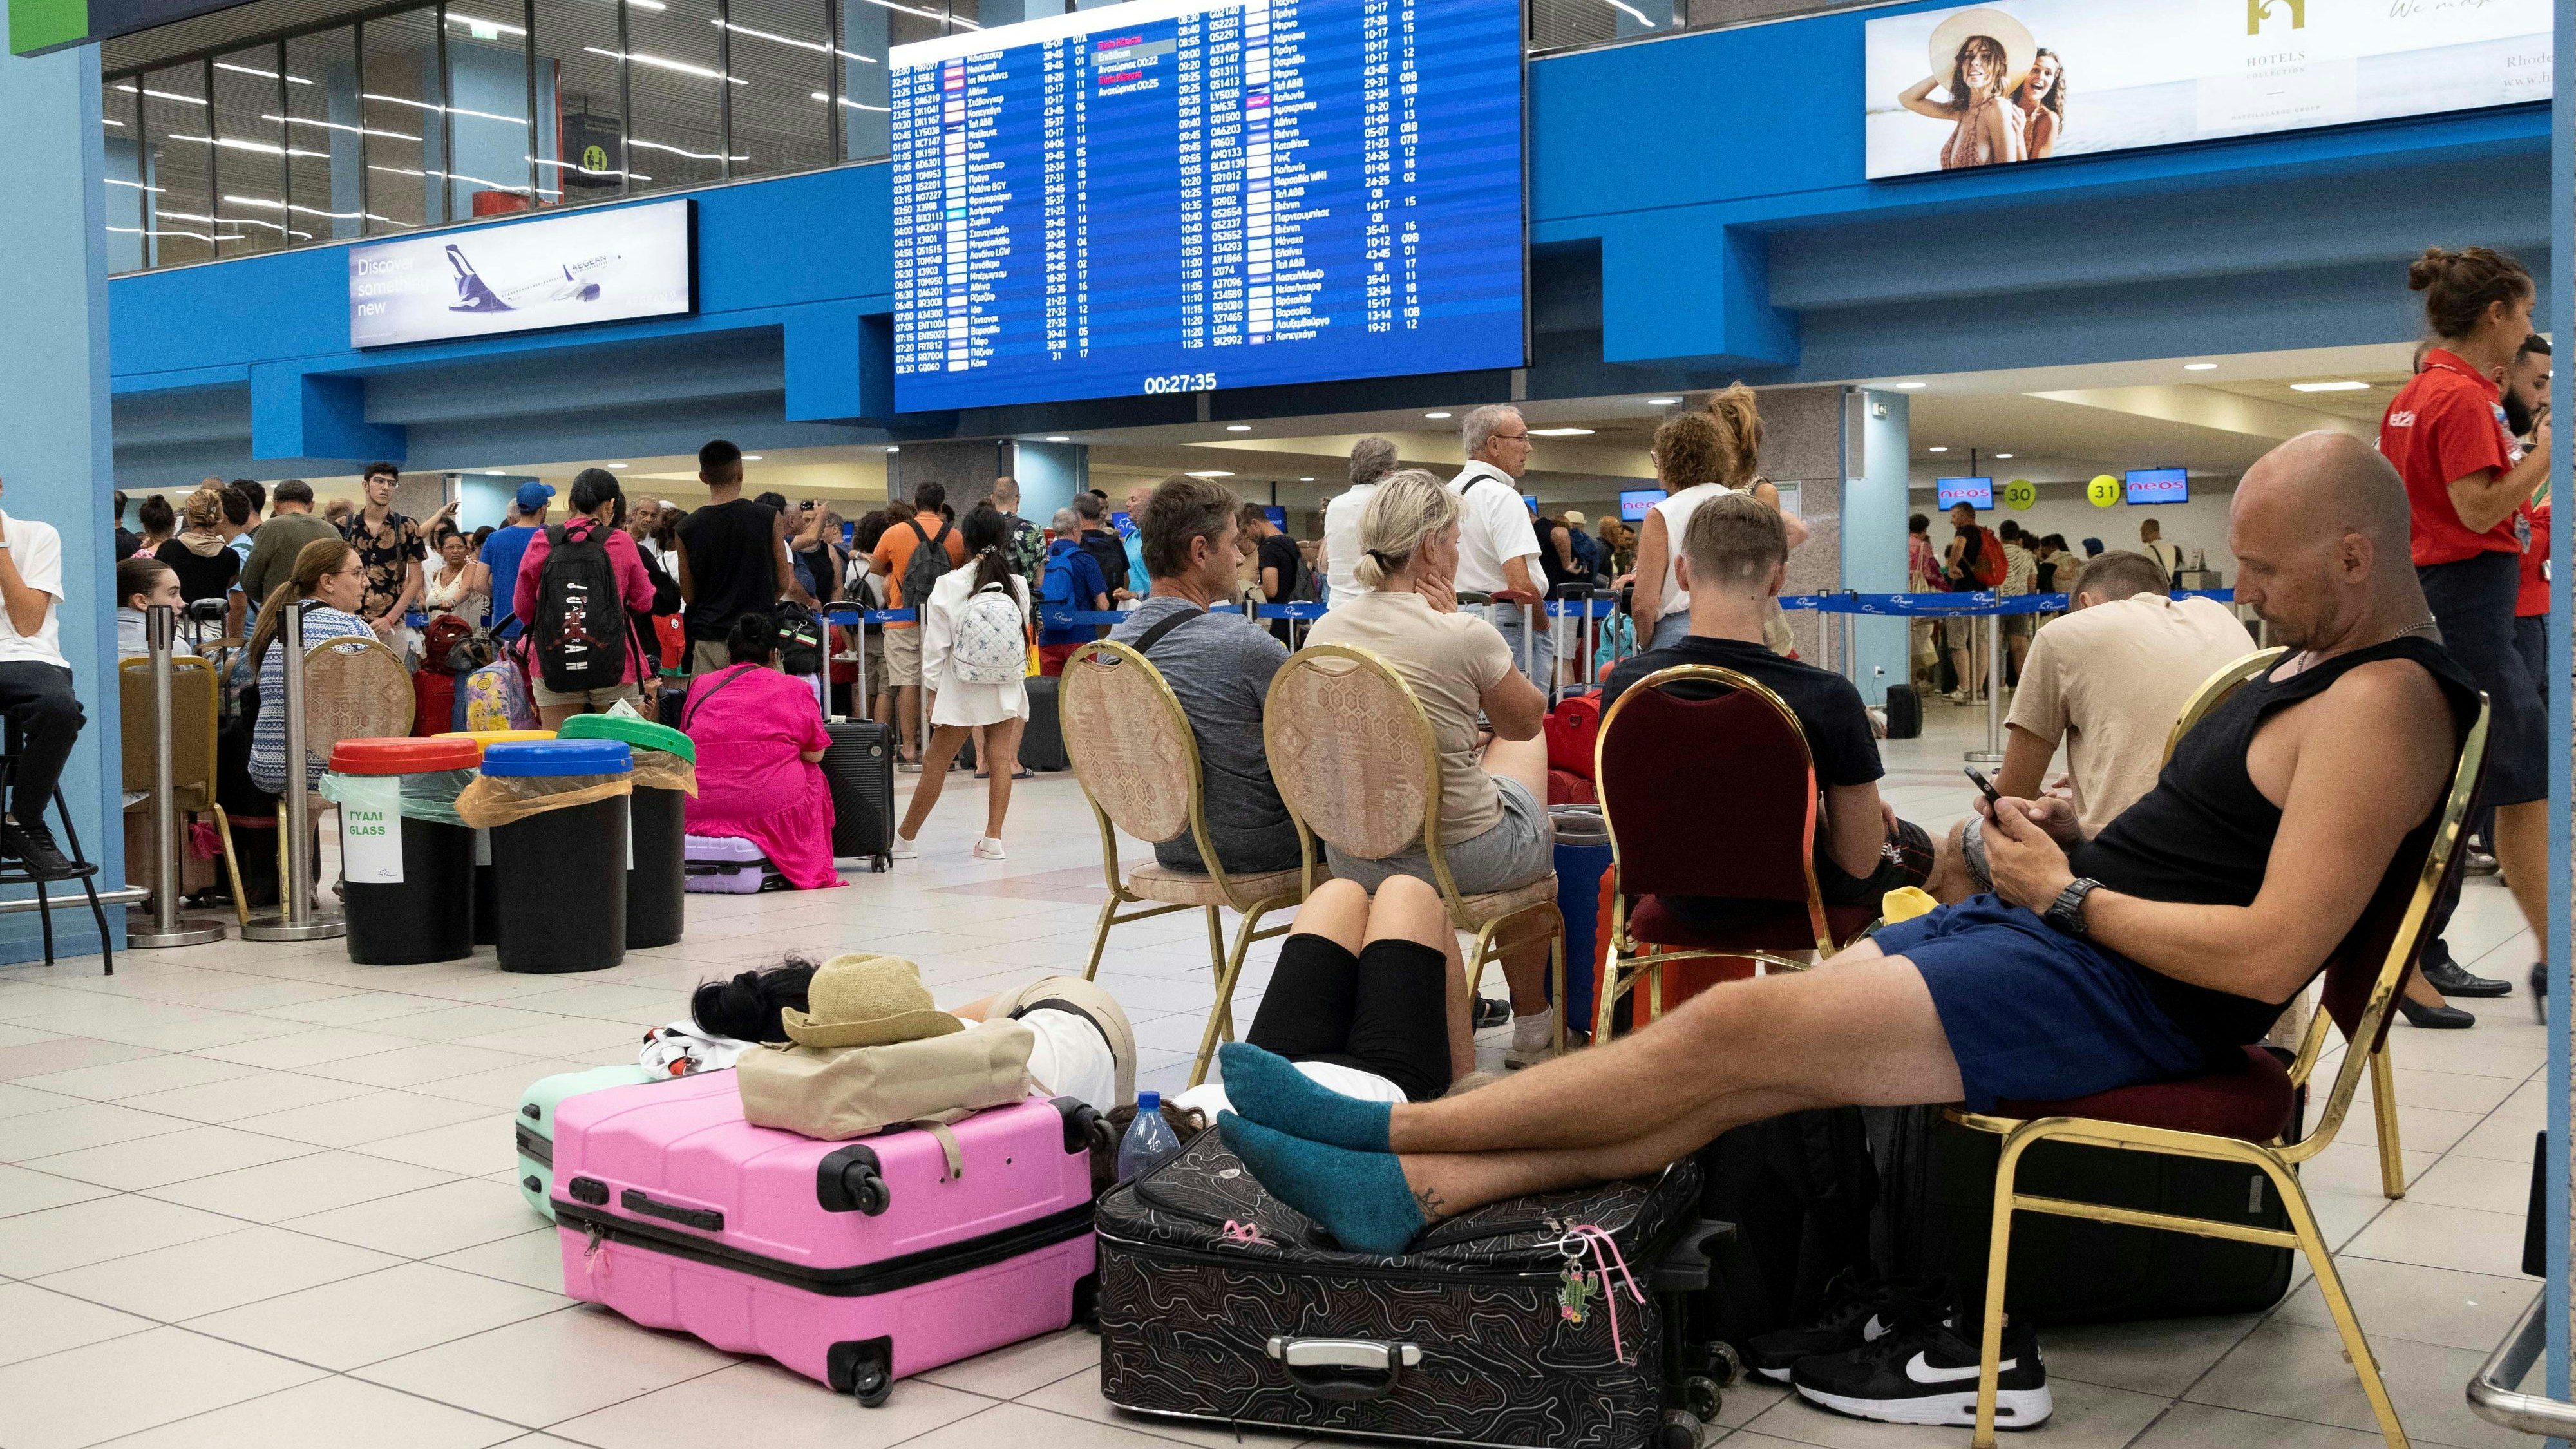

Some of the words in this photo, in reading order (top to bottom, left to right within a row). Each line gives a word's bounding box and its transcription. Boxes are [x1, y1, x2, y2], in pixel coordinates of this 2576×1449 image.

[1178, 48, 1200, 60] 09:00
[1209, 41, 1240, 55] A33496
[1363, 14, 1387, 28] 27-28
[1178, 59, 1200, 71] 09:20
[1403, 22, 1414, 33] 15
[1137, 57, 1158, 67] 00:22
[2247, 50, 2305, 67] HOTELS
[2506, 52, 2552, 68] Rhode
[892, 87, 910, 98] 23:25
[1075, 56, 1084, 66] 01
[1044, 71, 1064, 83] 18-20
[1076, 68, 1085, 77] 16
[2246, 66, 2305, 79] COLLECTION
[2503, 73, 2552, 86] www.h
[891, 76, 910, 88] 22:40
[1137, 79, 1159, 89] 00:25
[1178, 94, 1200, 106] 09:35
[1210, 88, 1240, 101] LY5036
[1210, 100, 1236, 113] EW635
[1364, 76, 1387, 88] 29-31
[1399, 71, 1417, 82] 09B
[1364, 88, 1389, 100] 32-34
[1401, 83, 1417, 95] 10B
[914, 104, 938, 116] DK1041
[2295, 105, 2321, 113] GROUP
[892, 119, 911, 130] 00:30
[914, 114, 940, 127] DK1167
[1210, 136, 1235, 148] FR603
[1404, 109, 1415, 120] 13
[1364, 125, 1388, 138] 05-07
[893, 140, 911, 151] 01:00
[915, 135, 940, 147] RC7147
[1044, 138, 1065, 149] 04-06
[1077, 135, 1086, 144] 14
[915, 147, 939, 158] DK1591
[1180, 176, 1201, 187] 10:20
[1211, 170, 1241, 183] XR1012
[1365, 149, 1389, 162] 24-26
[1180, 164, 1201, 175] 10:05
[893, 184, 912, 194] 03:10
[893, 194, 912, 205] 03:15
[992, 181, 1006, 190] BGY
[1045, 173, 1063, 184] 27-31
[1077, 180, 1086, 189] 17
[1211, 182, 1239, 194] FR7491
[1180, 200, 1202, 211] 10:35
[1212, 195, 1236, 207] XR902
[916, 211, 943, 223] BIX3113
[916, 222, 942, 233] WK2341
[1045, 205, 1065, 216] 21-23
[1045, 228, 1065, 240] 32-34
[1078, 225, 1086, 235] 12
[1212, 241, 1242, 252] X34293
[1405, 220, 1416, 231] 16
[894, 237, 913, 247] 04:15
[916, 234, 937, 245] X3901
[1181, 257, 1202, 268] 11:00
[1211, 252, 1242, 265] AY1866
[1367, 236, 1390, 247] 10-12
[358, 257, 413, 276] Discover
[571, 255, 607, 271] AEGEAN
[917, 265, 938, 276] X3903
[916, 276, 943, 287] TOM950
[1182, 281, 1202, 292] 11:05
[1212, 277, 1242, 289] A37096
[1182, 292, 1202, 303] 11:10
[1213, 289, 1242, 300] X34589
[1367, 273, 1389, 285] 35-41
[358, 302, 386, 317] new
[895, 312, 914, 321] 07:00
[917, 308, 943, 319] A34300
[917, 319, 946, 330] ENT1004
[1046, 307, 1066, 317] 27-32
[1079, 304, 1088, 314] 12
[1213, 312, 1243, 323] 3Z7465
[1213, 323, 1237, 335] LG846
[1367, 309, 1391, 321] 13-14
[1182, 338, 1203, 348] 11:25
[1213, 335, 1242, 346] SK2992
[1368, 321, 1390, 332] 19-21
[1406, 319, 1417, 329] 12
[918, 340, 942, 350] FR7812
[918, 351, 943, 361] RR7004
[1047, 339, 1066, 350] 35-38
[896, 364, 914, 374] 08:30
[1079, 348, 1088, 357] 17
[1144, 373, 1217, 395] 00:27:35
[2095, 486, 2113, 498] 31
[2129, 480, 2184, 490] neos
[1940, 489, 1989, 498] neos
[2009, 488, 2030, 501] 30
[1623, 501, 1656, 509] neo
[350, 811, 383, 820] ΓΥΑΛΙ
[350, 826, 385, 835] GLASS
